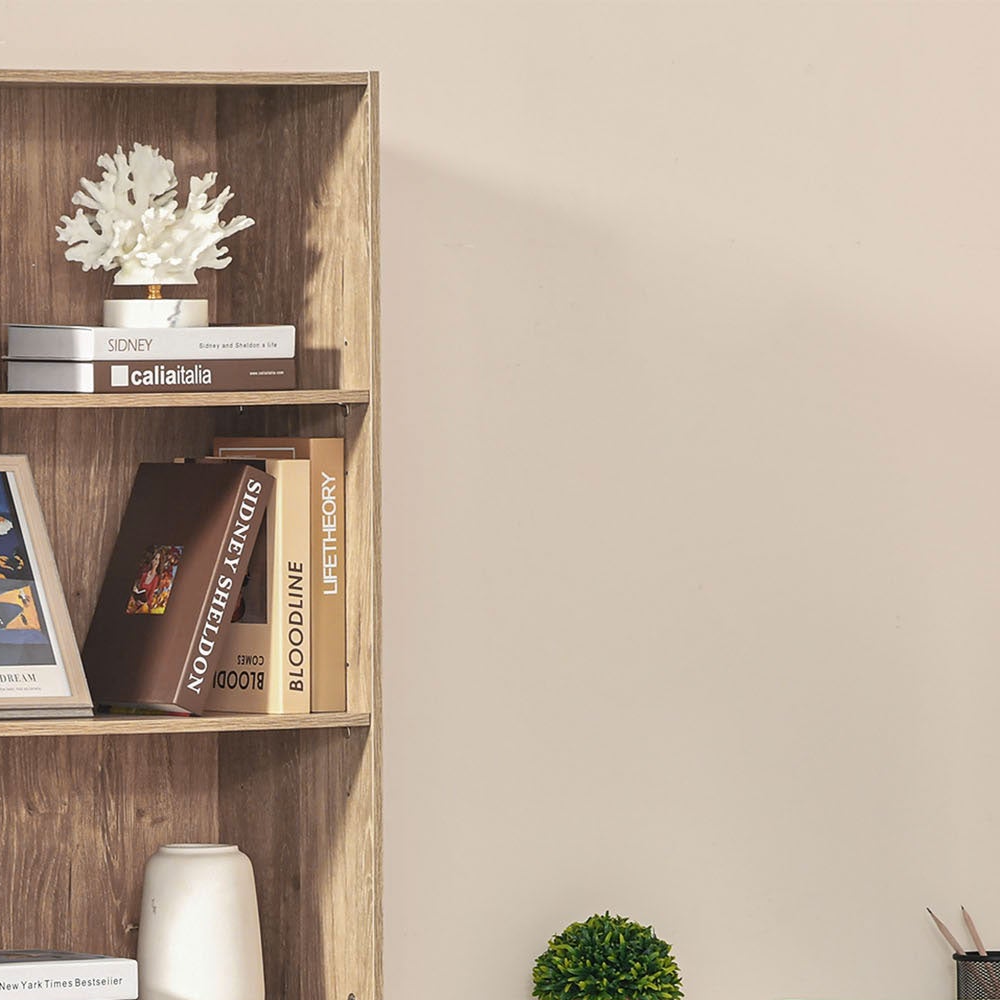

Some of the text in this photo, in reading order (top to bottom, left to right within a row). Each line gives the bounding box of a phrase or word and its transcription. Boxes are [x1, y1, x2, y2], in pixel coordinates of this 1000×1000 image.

[107, 338, 153, 352] SIDNEY
[199, 342, 220, 350] Sidney
[131, 364, 212, 386] caliaitalia
[321, 471, 338, 595] LIFETHEORY
[187, 478, 262, 695] SIDNEY SHELDON
[288, 561, 304, 692] BLOODLINE
[237, 654, 265, 666] COMES
[44, 978, 73, 989] Times
